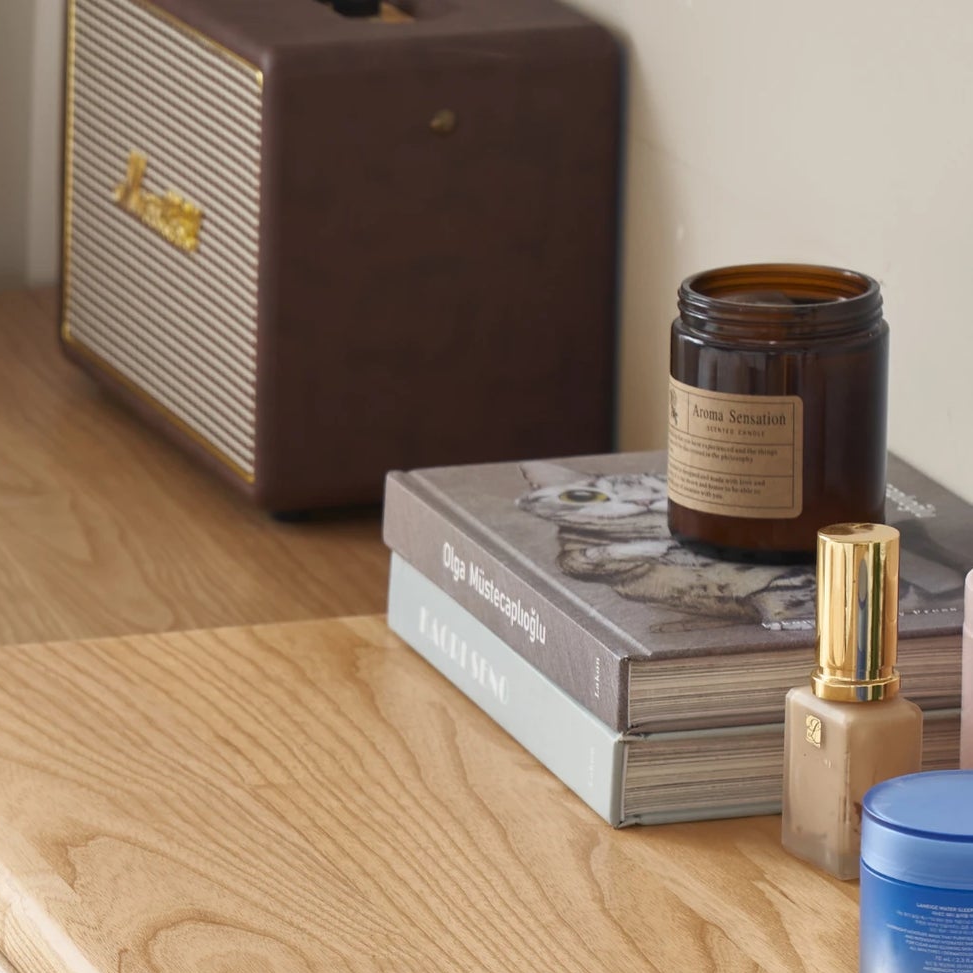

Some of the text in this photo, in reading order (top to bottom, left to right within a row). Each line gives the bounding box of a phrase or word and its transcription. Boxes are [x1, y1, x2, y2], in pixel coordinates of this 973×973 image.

[693, 404, 787, 426] Aroma Sensation
[443, 541, 466, 582] Olga
